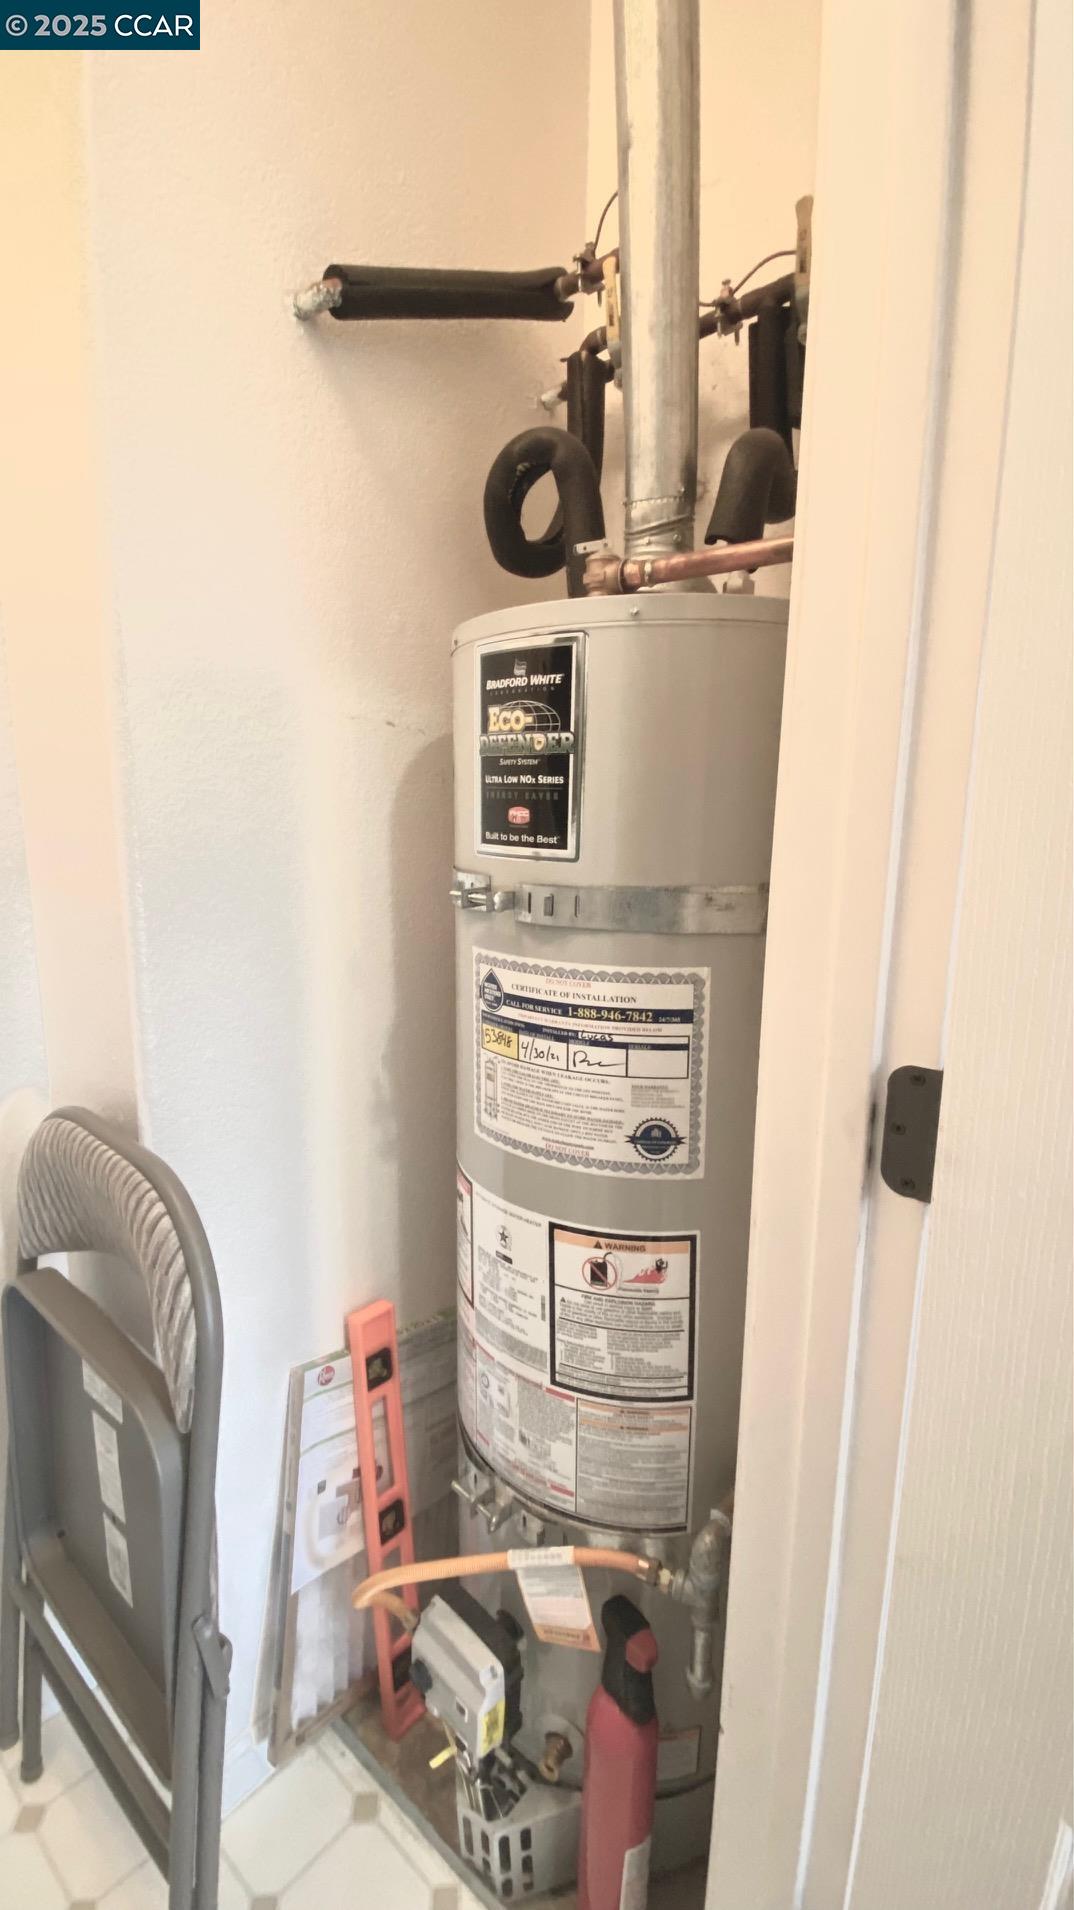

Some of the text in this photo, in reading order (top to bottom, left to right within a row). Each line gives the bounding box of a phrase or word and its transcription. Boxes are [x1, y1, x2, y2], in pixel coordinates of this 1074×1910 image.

[486, 673, 562, 690] BRADFORD WHITE
[480, 731, 575, 755] DEFENDER
[485, 774, 503, 784] ULTRA
[504, 774, 518, 784] LOW
[537, 774, 564, 785] SERIES
[485, 831, 558, 844] Built to be the Best
[511, 983, 556, 997] CERTIFICATE
[572, 992, 637, 1003] INSTALLATION
[506, 999, 520, 1008] CALL
[535, 1004, 563, 1015] SERVICE
[568, 1006, 653, 1022] 1-888-946-7842
[604, 1241, 646, 1253] WARNING
